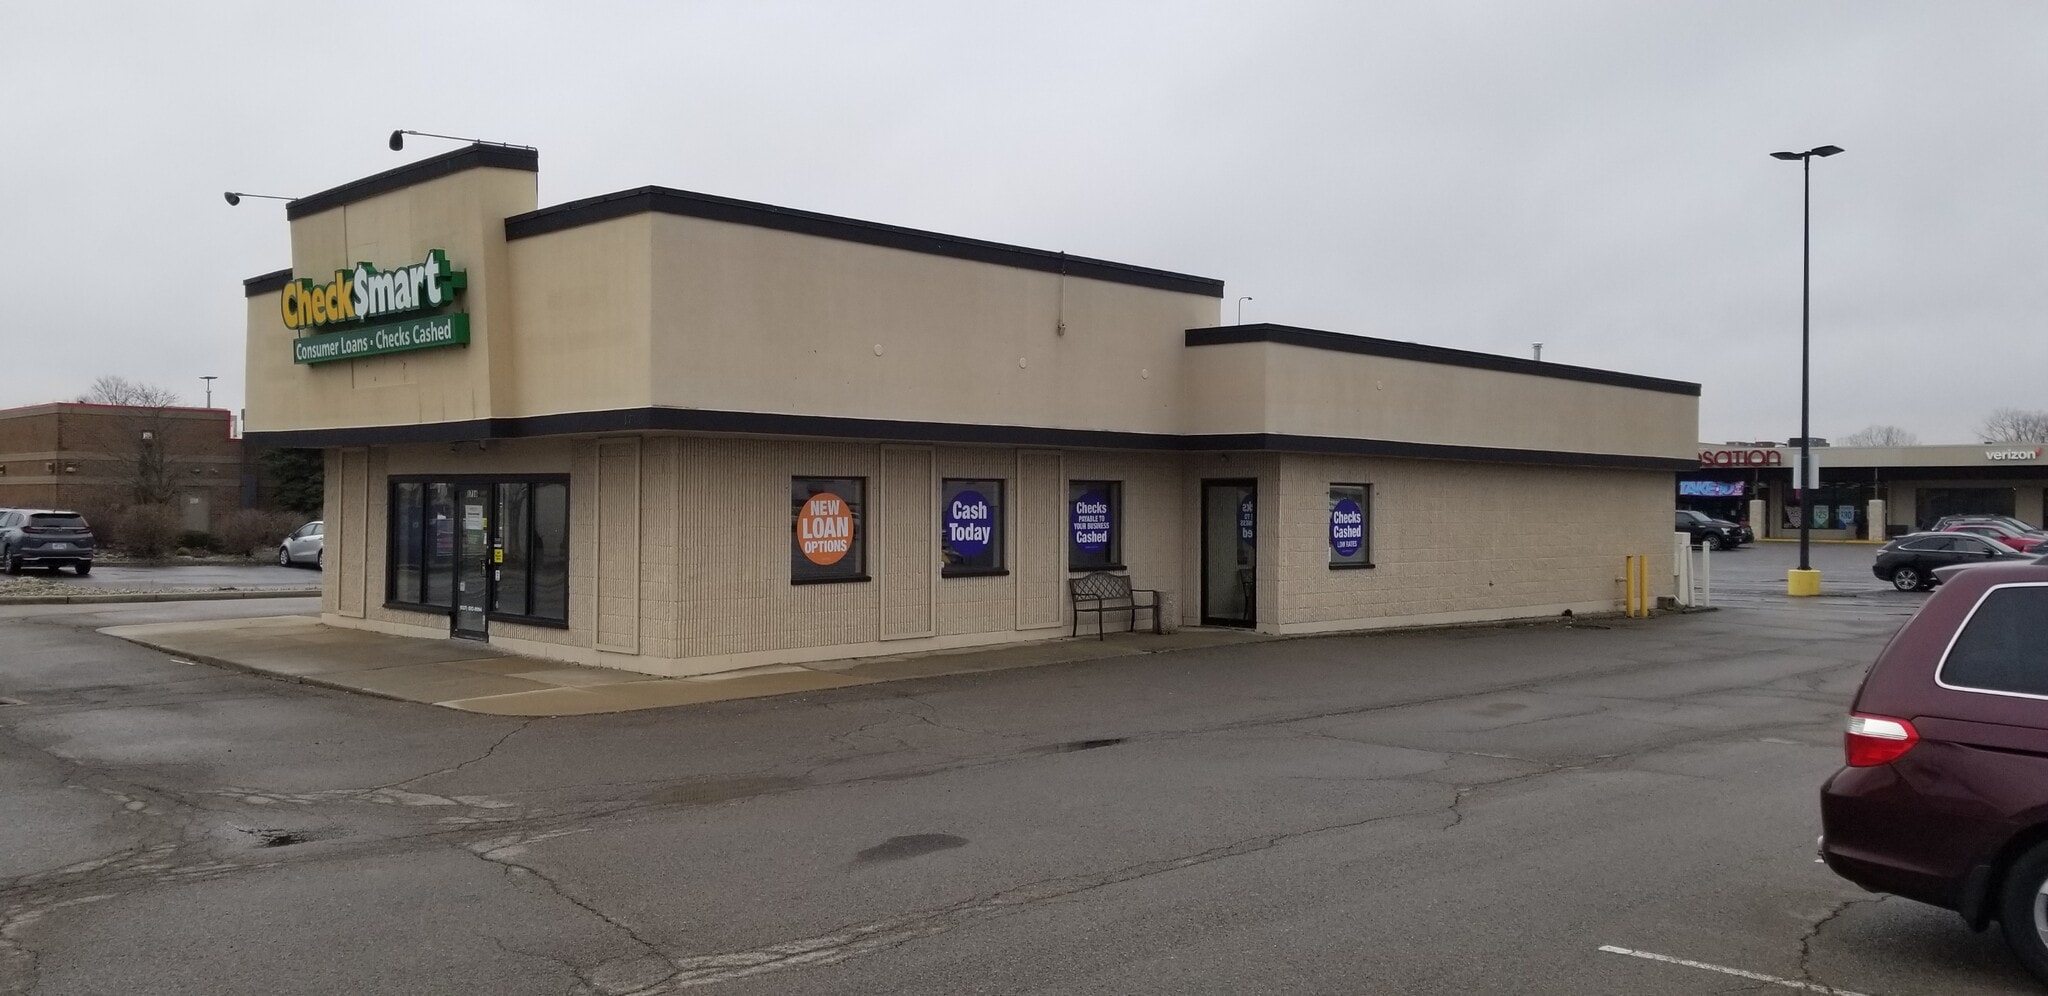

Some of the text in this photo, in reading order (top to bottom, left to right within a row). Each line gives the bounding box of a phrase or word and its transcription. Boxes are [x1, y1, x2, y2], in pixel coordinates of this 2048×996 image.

[296, 319, 452, 360] Consumer Loans Checks Cashed
[1985, 449, 2036, 460] verizon
[810, 500, 840, 516] NEW
[952, 500, 988, 520] Cash
[1076, 501, 1107, 514] Checks
[1333, 511, 1361, 524] Checks
[802, 517, 849, 539] LOAN
[949, 522, 991, 545] Today
[1333, 525, 1362, 538] Cashed
[1076, 530, 1107, 543] Cashed
[804, 539, 848, 554] OPTIONS
